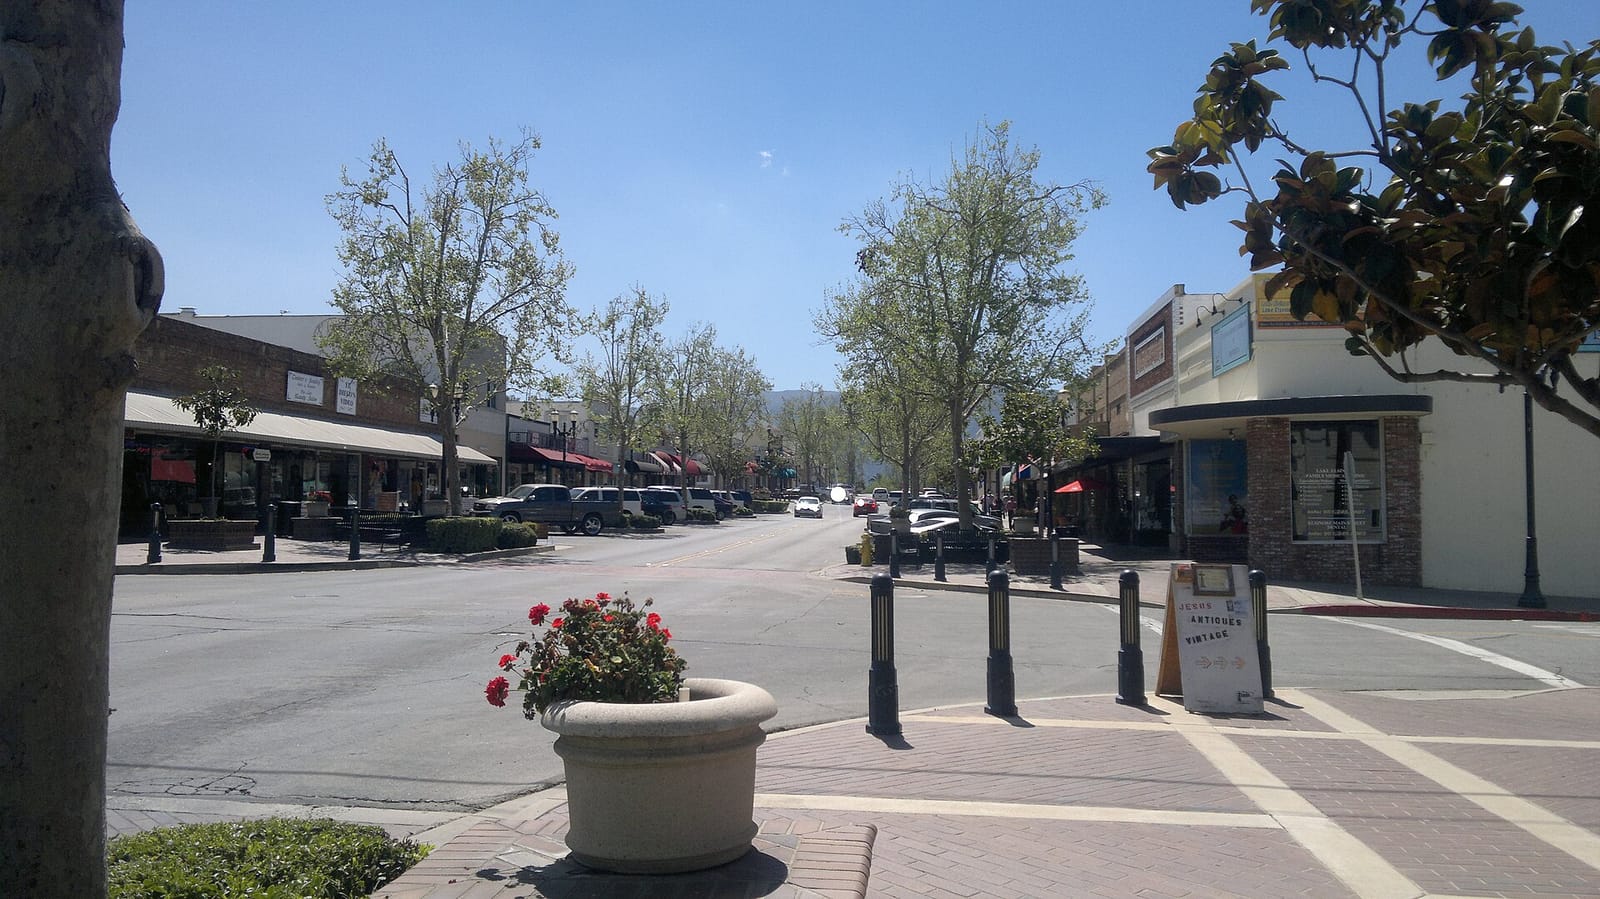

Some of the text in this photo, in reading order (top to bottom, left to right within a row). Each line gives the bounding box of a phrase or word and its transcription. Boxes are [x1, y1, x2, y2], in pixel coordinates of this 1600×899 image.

[1179, 602, 1213, 611] JESUS
[1191, 615, 1243, 627] ANTIQUES
[1186, 630, 1230, 645] VINTAGE
